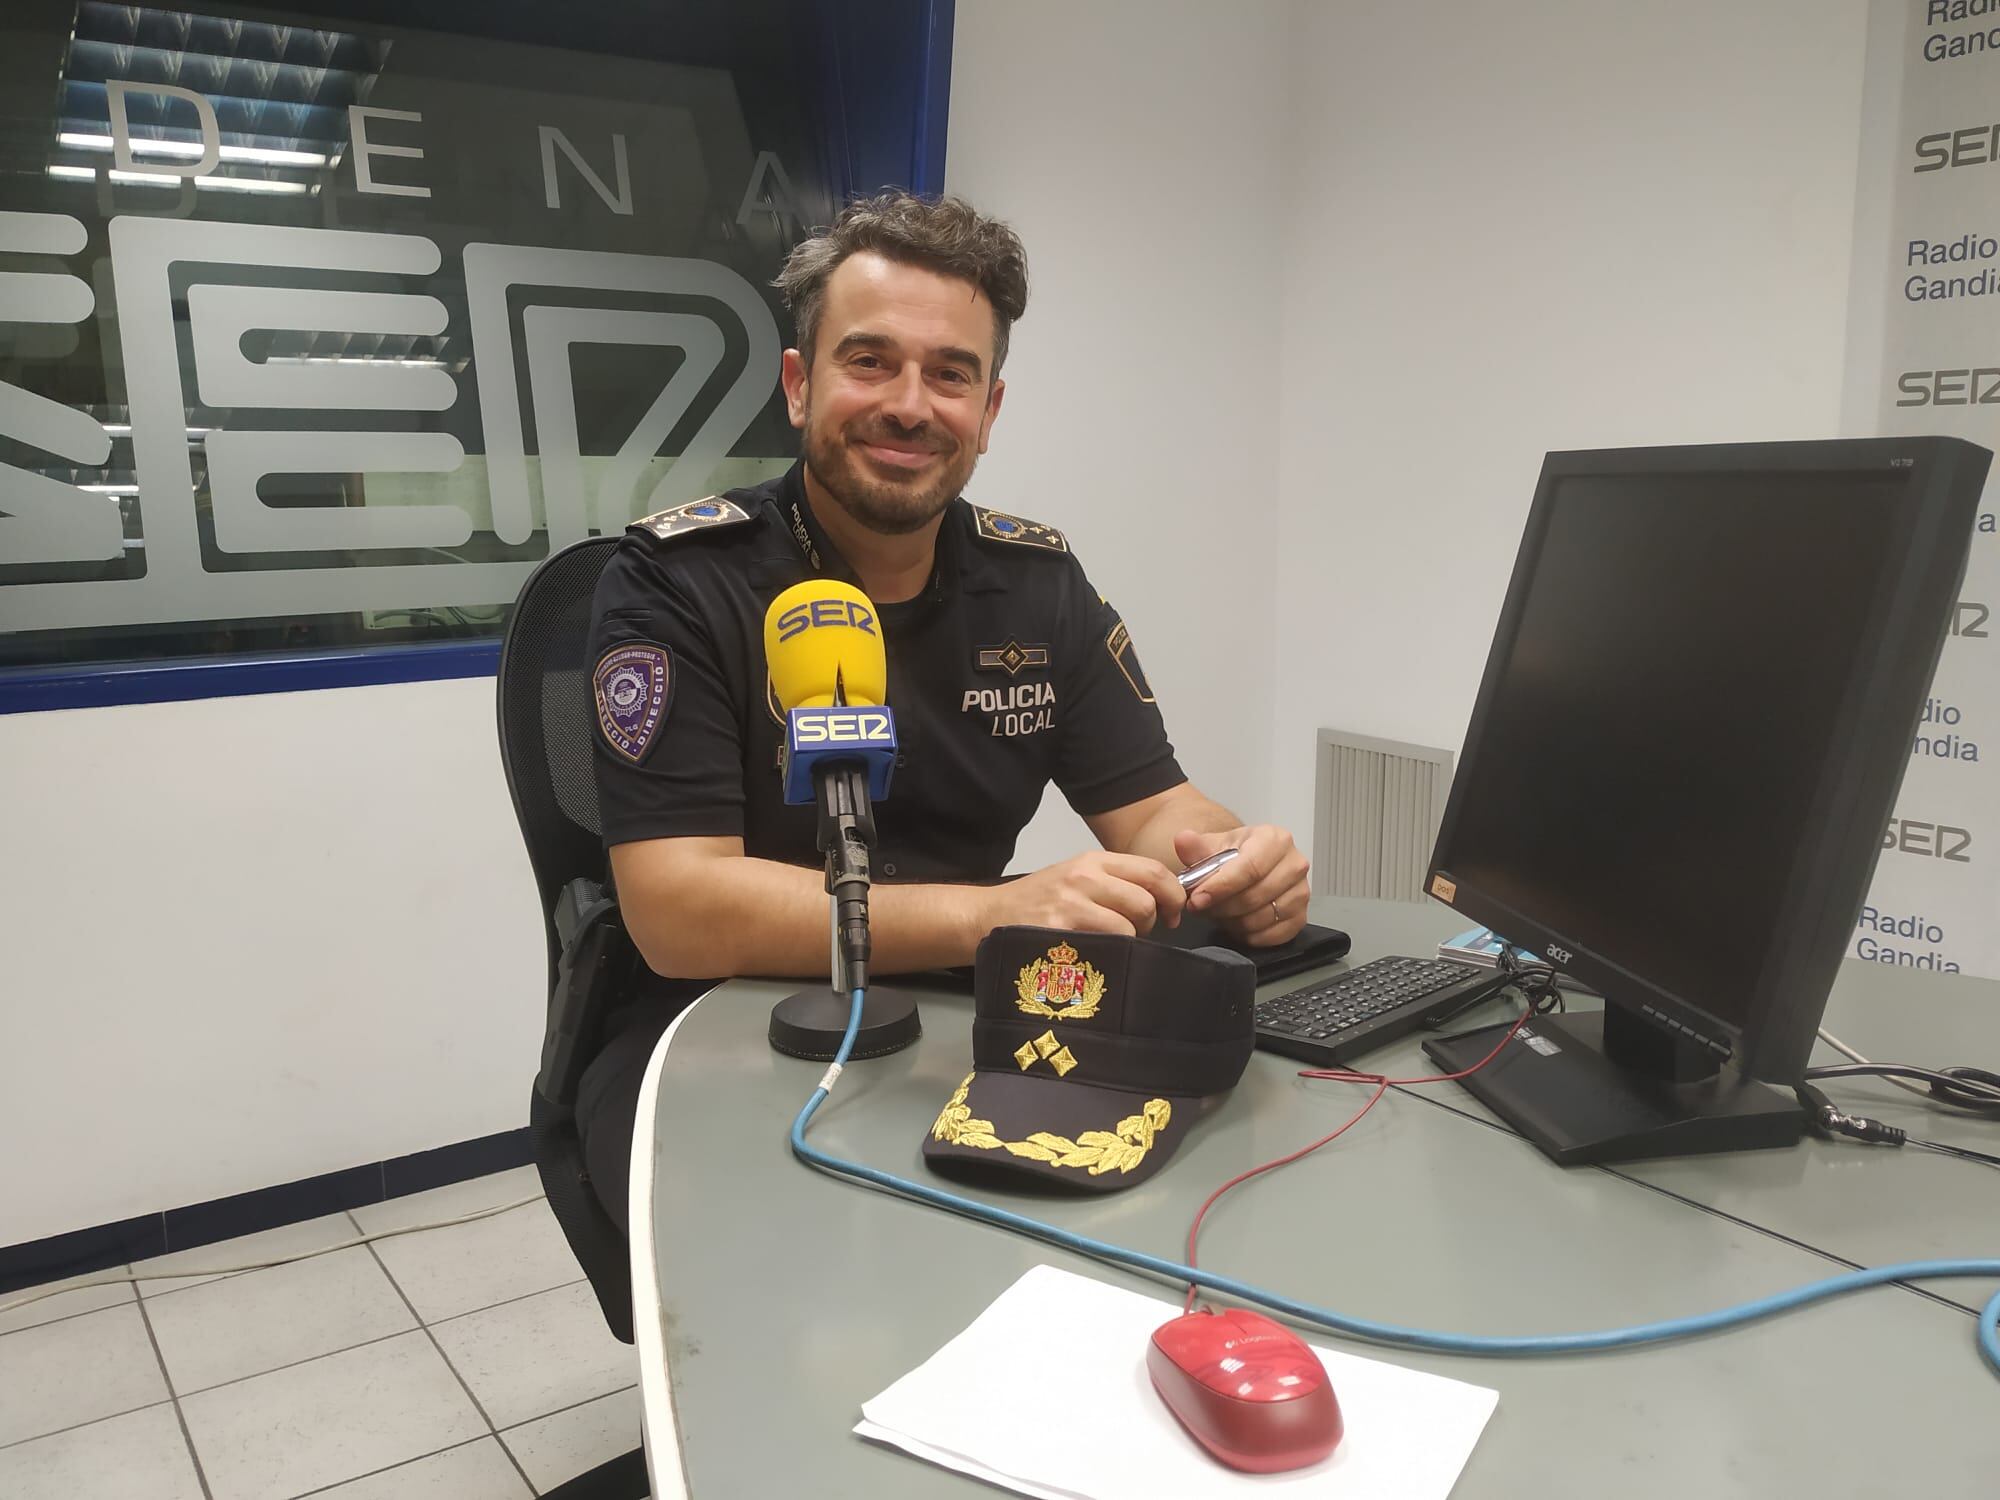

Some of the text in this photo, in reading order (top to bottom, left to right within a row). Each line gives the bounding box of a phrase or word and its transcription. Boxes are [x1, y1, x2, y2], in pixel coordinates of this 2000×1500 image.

[1914, 123, 2000, 173] SE
[1908, 233, 1998, 267] Radio
[1904, 268, 2000, 302] Gandi
[1896, 367, 2000, 407] SER
[777, 600, 876, 643] SER
[961, 682, 1056, 713] POLICIA
[1920, 698, 1961, 725] dio
[796, 714, 891, 742] SER
[991, 708, 1056, 737] LOCAL
[1913, 735, 1979, 762] ndia
[1858, 906, 1943, 944] Radio
[1546, 943, 1573, 965] acer
